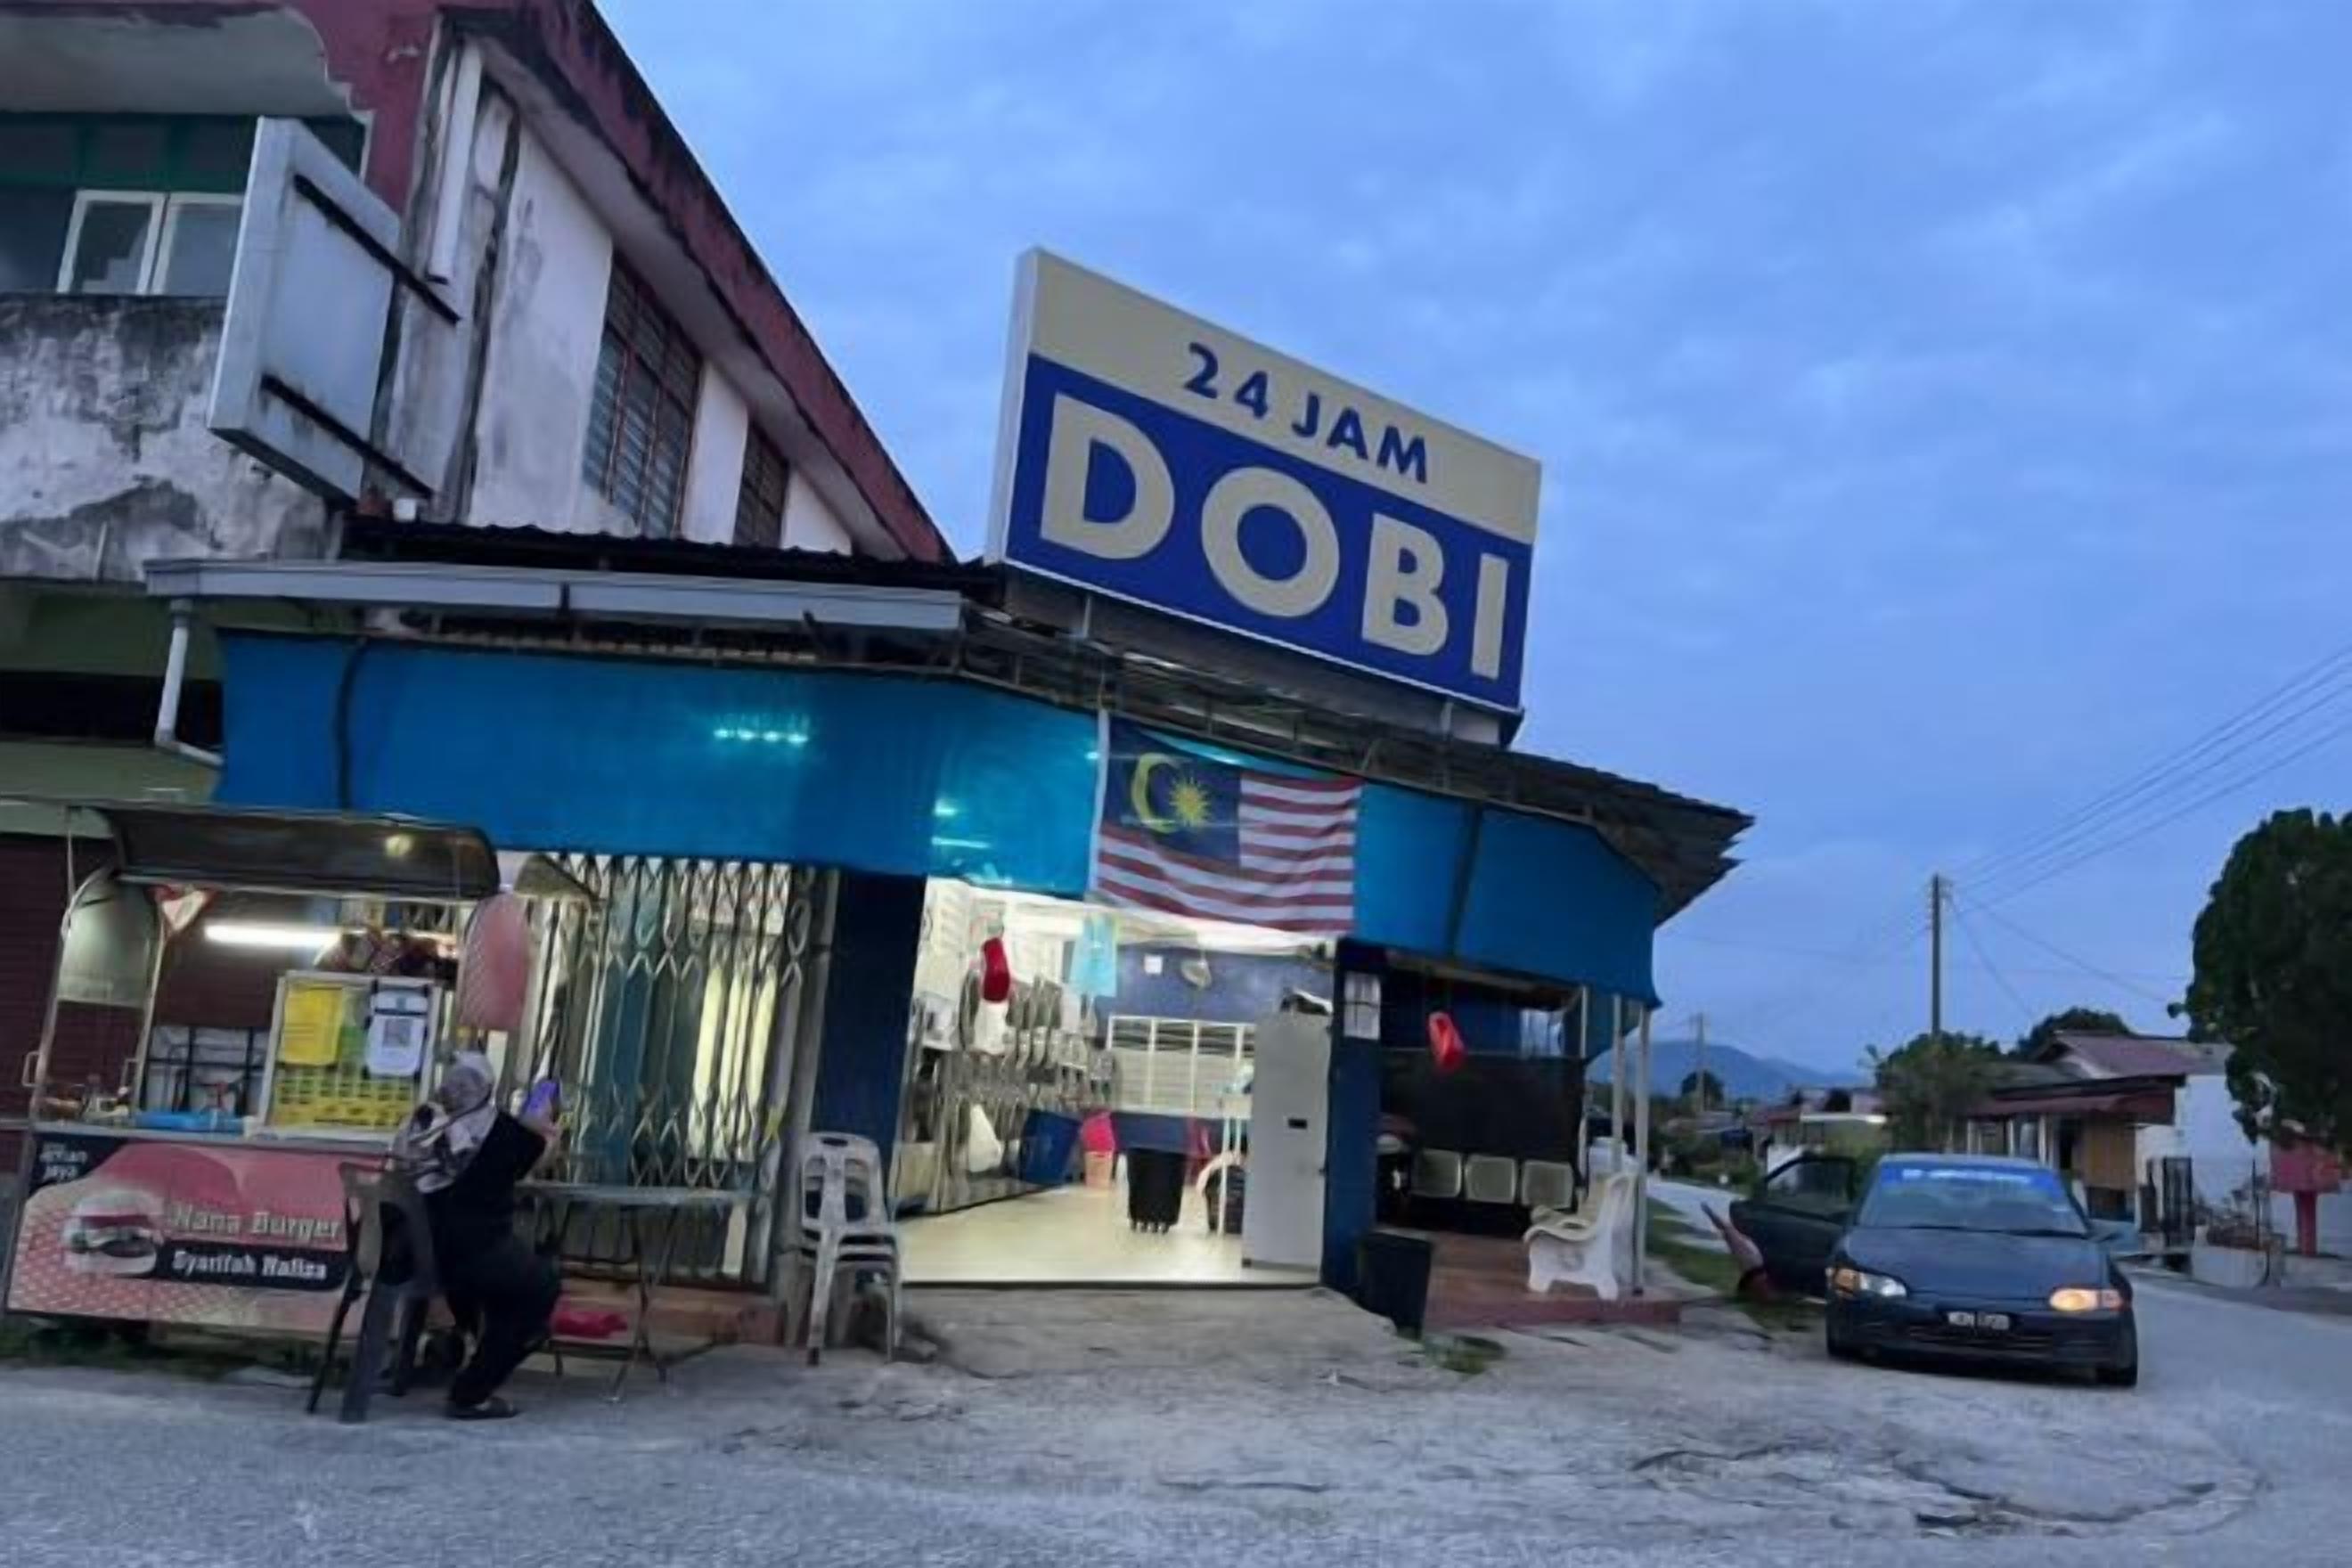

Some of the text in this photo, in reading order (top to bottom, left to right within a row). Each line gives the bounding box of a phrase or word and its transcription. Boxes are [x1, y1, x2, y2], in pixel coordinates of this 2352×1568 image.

[1183, 341, 1428, 484] 24 JAM
[1039, 390, 1511, 681] DOBI
[251, 1211, 340, 1241] Burger
